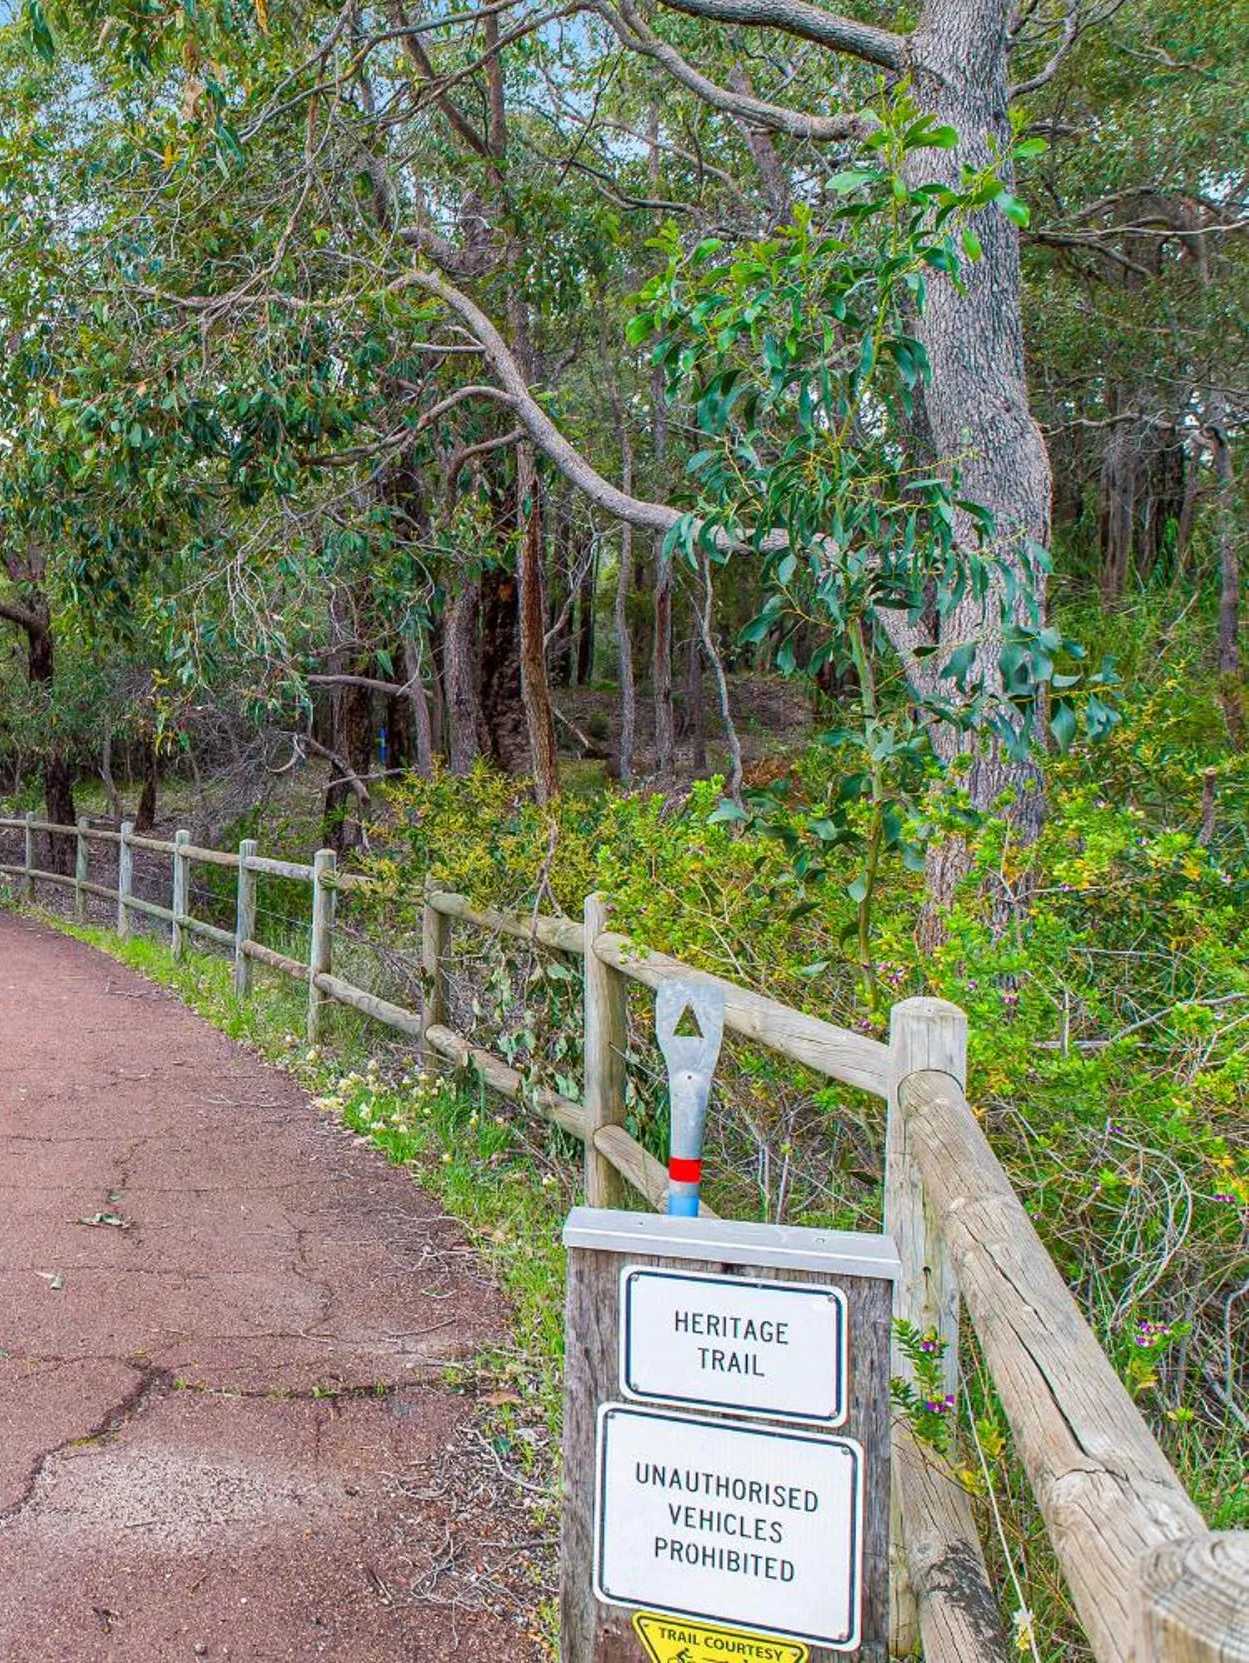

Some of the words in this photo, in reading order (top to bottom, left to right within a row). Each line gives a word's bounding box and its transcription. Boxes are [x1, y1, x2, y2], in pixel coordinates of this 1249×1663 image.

[674, 1310, 789, 1345] HERITAGE
[697, 1347, 766, 1377] TRAIL
[635, 1461, 819, 1513] UNAUTHORISED
[668, 1503, 783, 1544] VEHICLES
[654, 1536, 795, 1582] PROHIBITED
[658, 1626, 700, 1646] TRAIL
[704, 1635, 783, 1660] COURTESY
